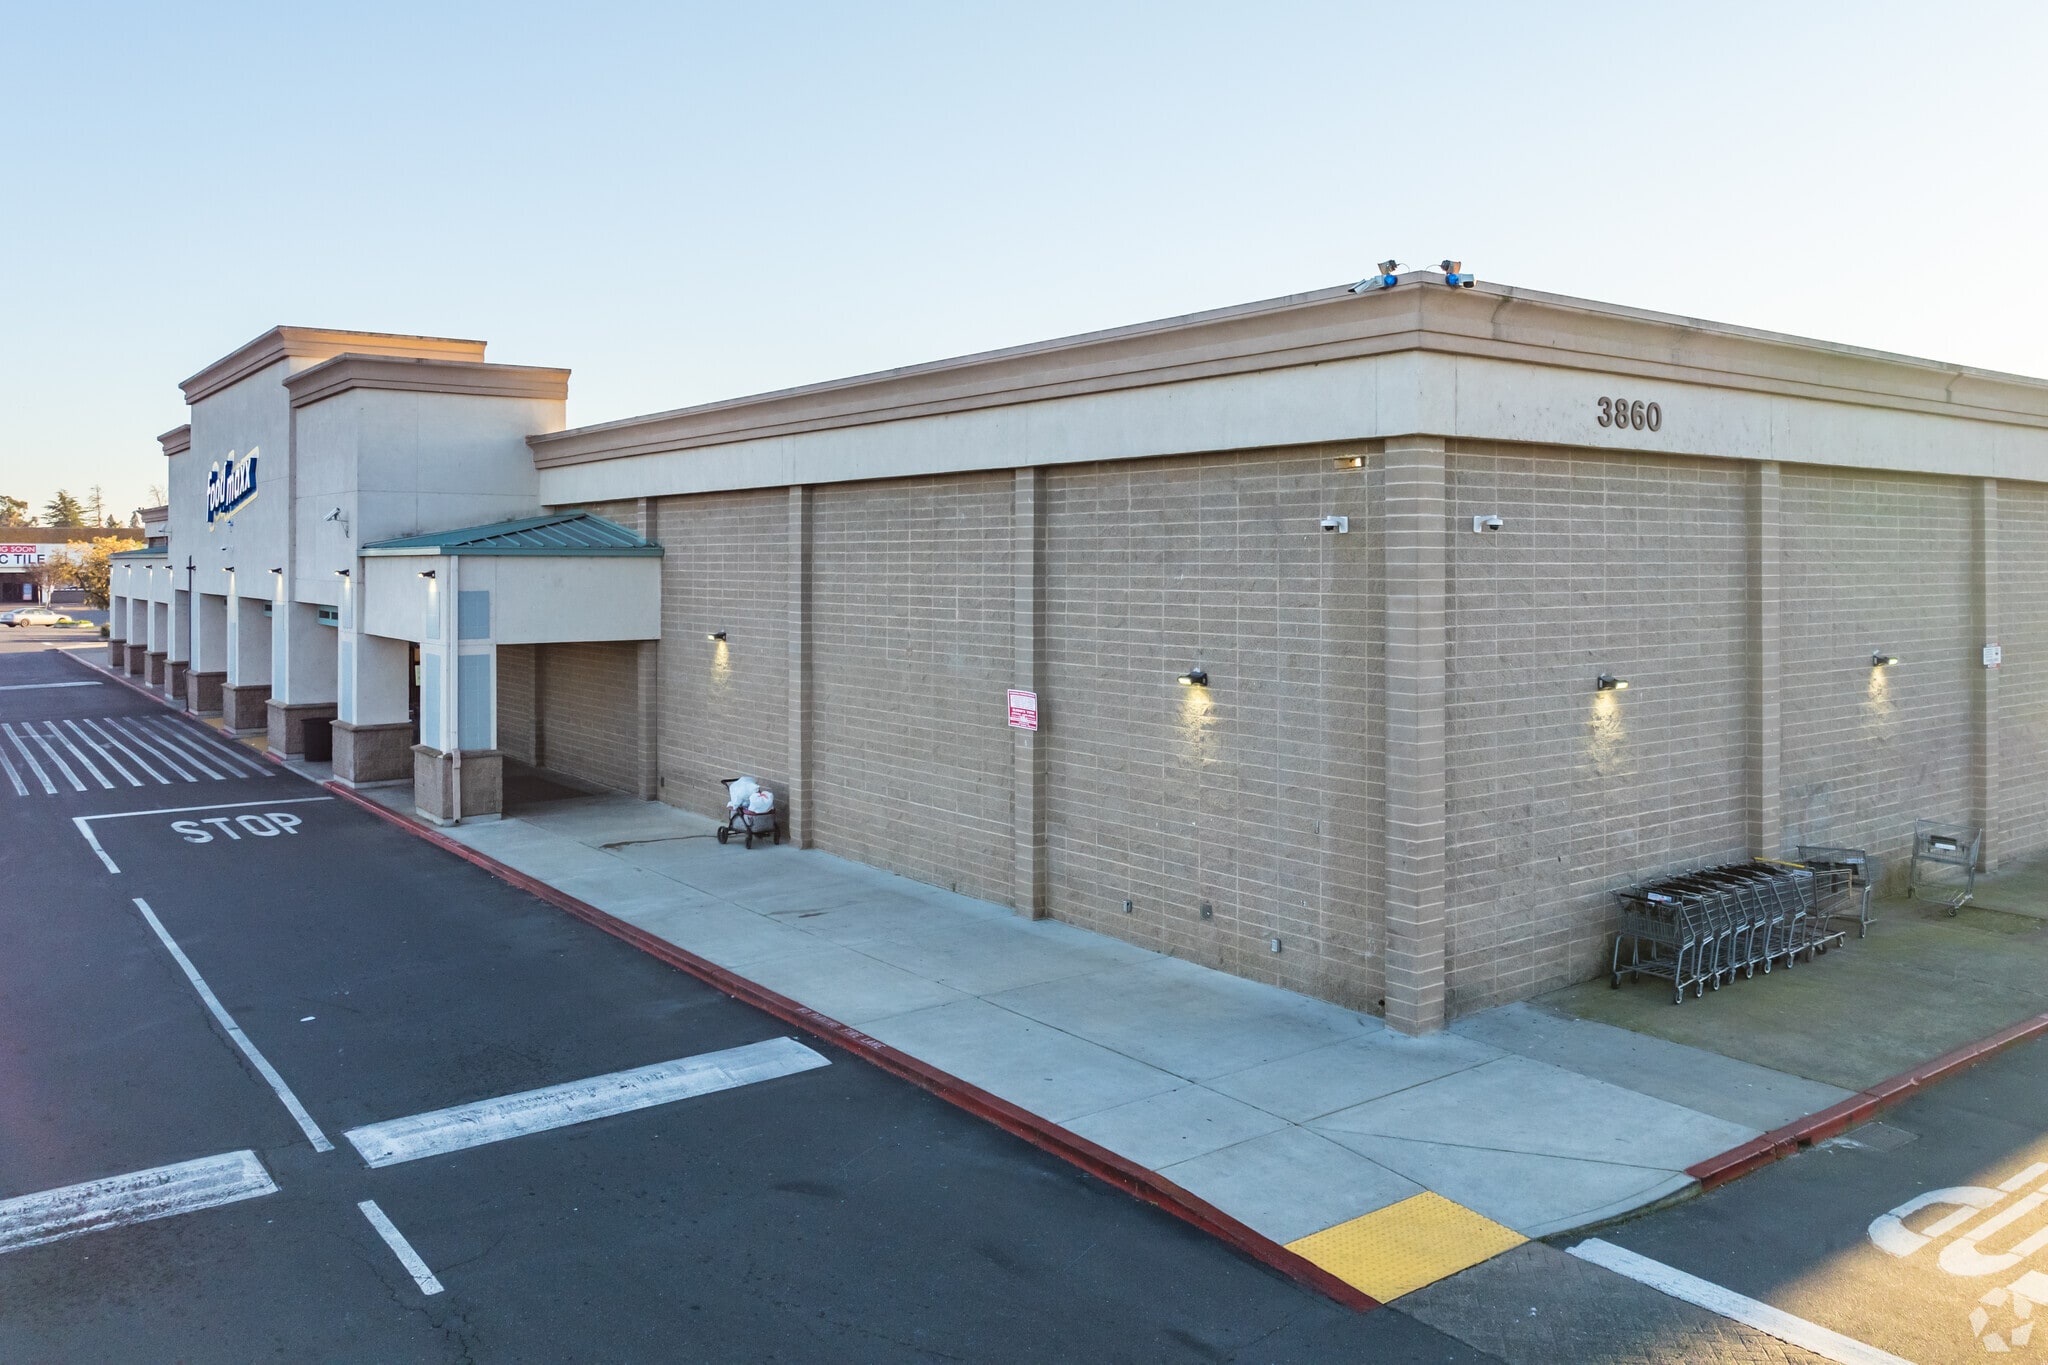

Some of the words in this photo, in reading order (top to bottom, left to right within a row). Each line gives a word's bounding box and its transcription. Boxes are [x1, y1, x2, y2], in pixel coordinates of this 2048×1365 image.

[1597, 396, 1663, 432] 3860
[14, 554, 46, 565] TILE
[170, 812, 303, 844] STOP
